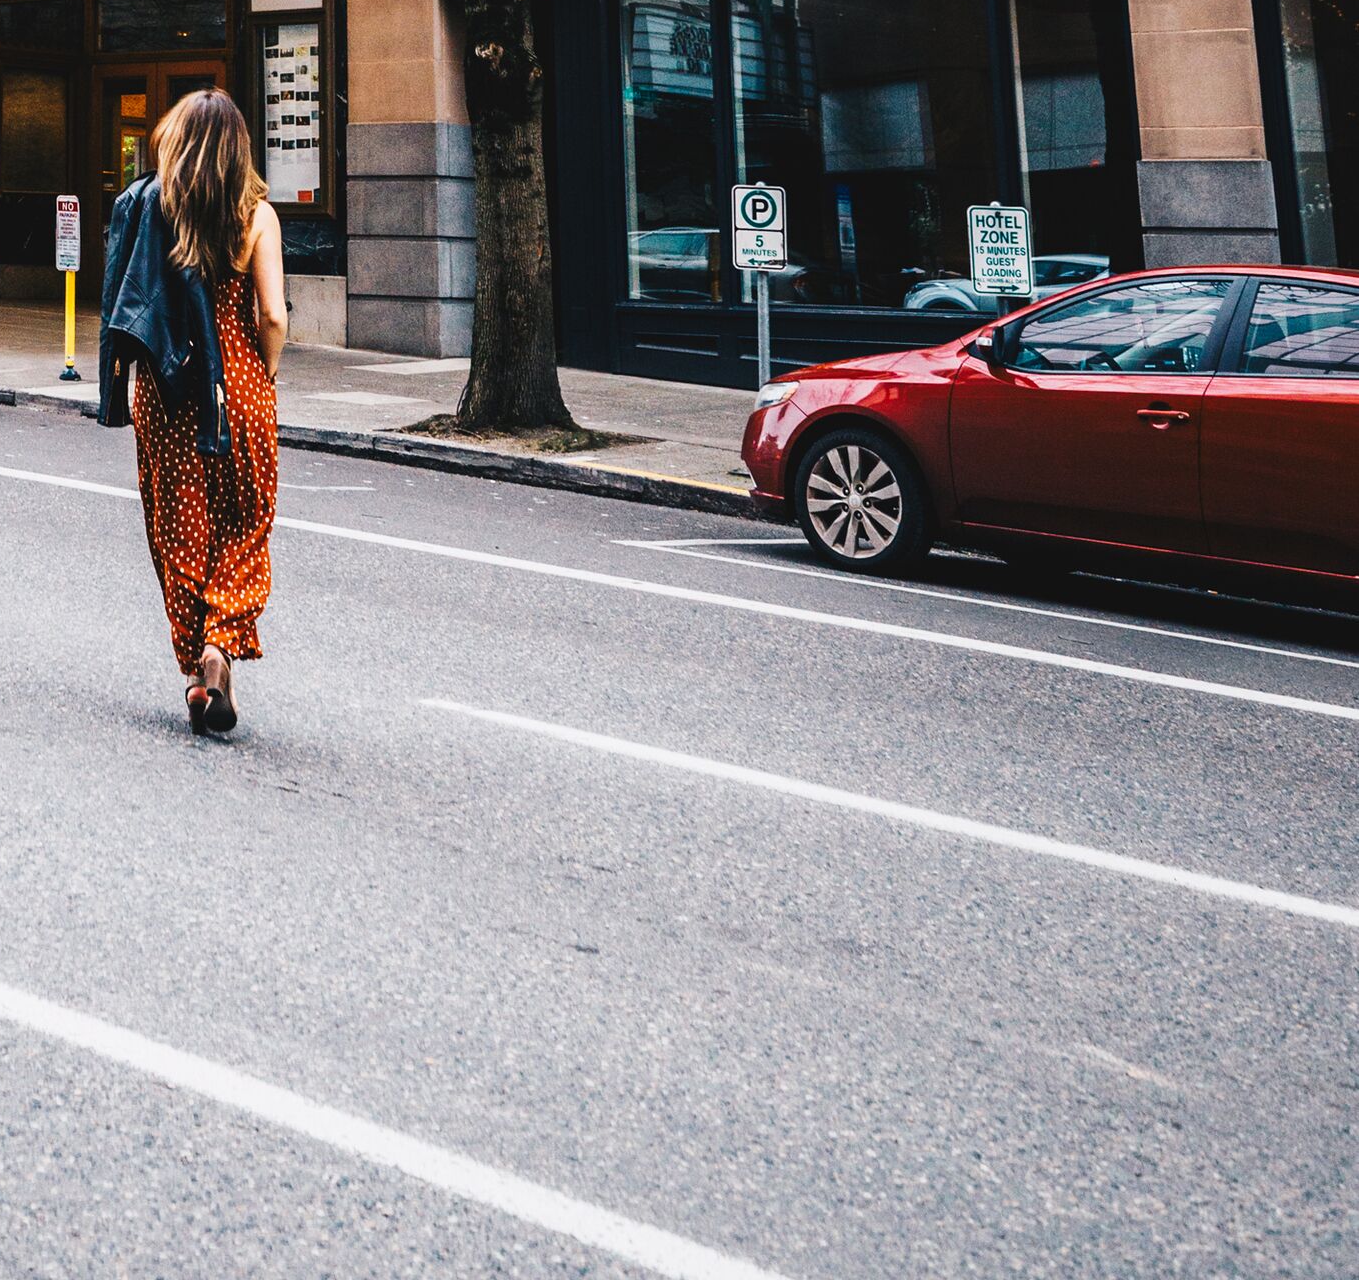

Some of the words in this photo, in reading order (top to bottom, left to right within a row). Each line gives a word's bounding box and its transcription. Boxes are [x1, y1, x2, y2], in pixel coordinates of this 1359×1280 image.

[62, 203, 74, 211] NO
[752, 198, 769, 220] P
[975, 214, 1023, 230] HOTEL
[755, 235, 764, 248] 5
[980, 230, 1019, 245] ZONE
[742, 248, 778, 257] MINUTES
[975, 246, 985, 254] 15
[986, 246, 1026, 256] MINUTES
[985, 257, 1016, 266] GUEST
[981, 268, 1022, 278] LOADING
